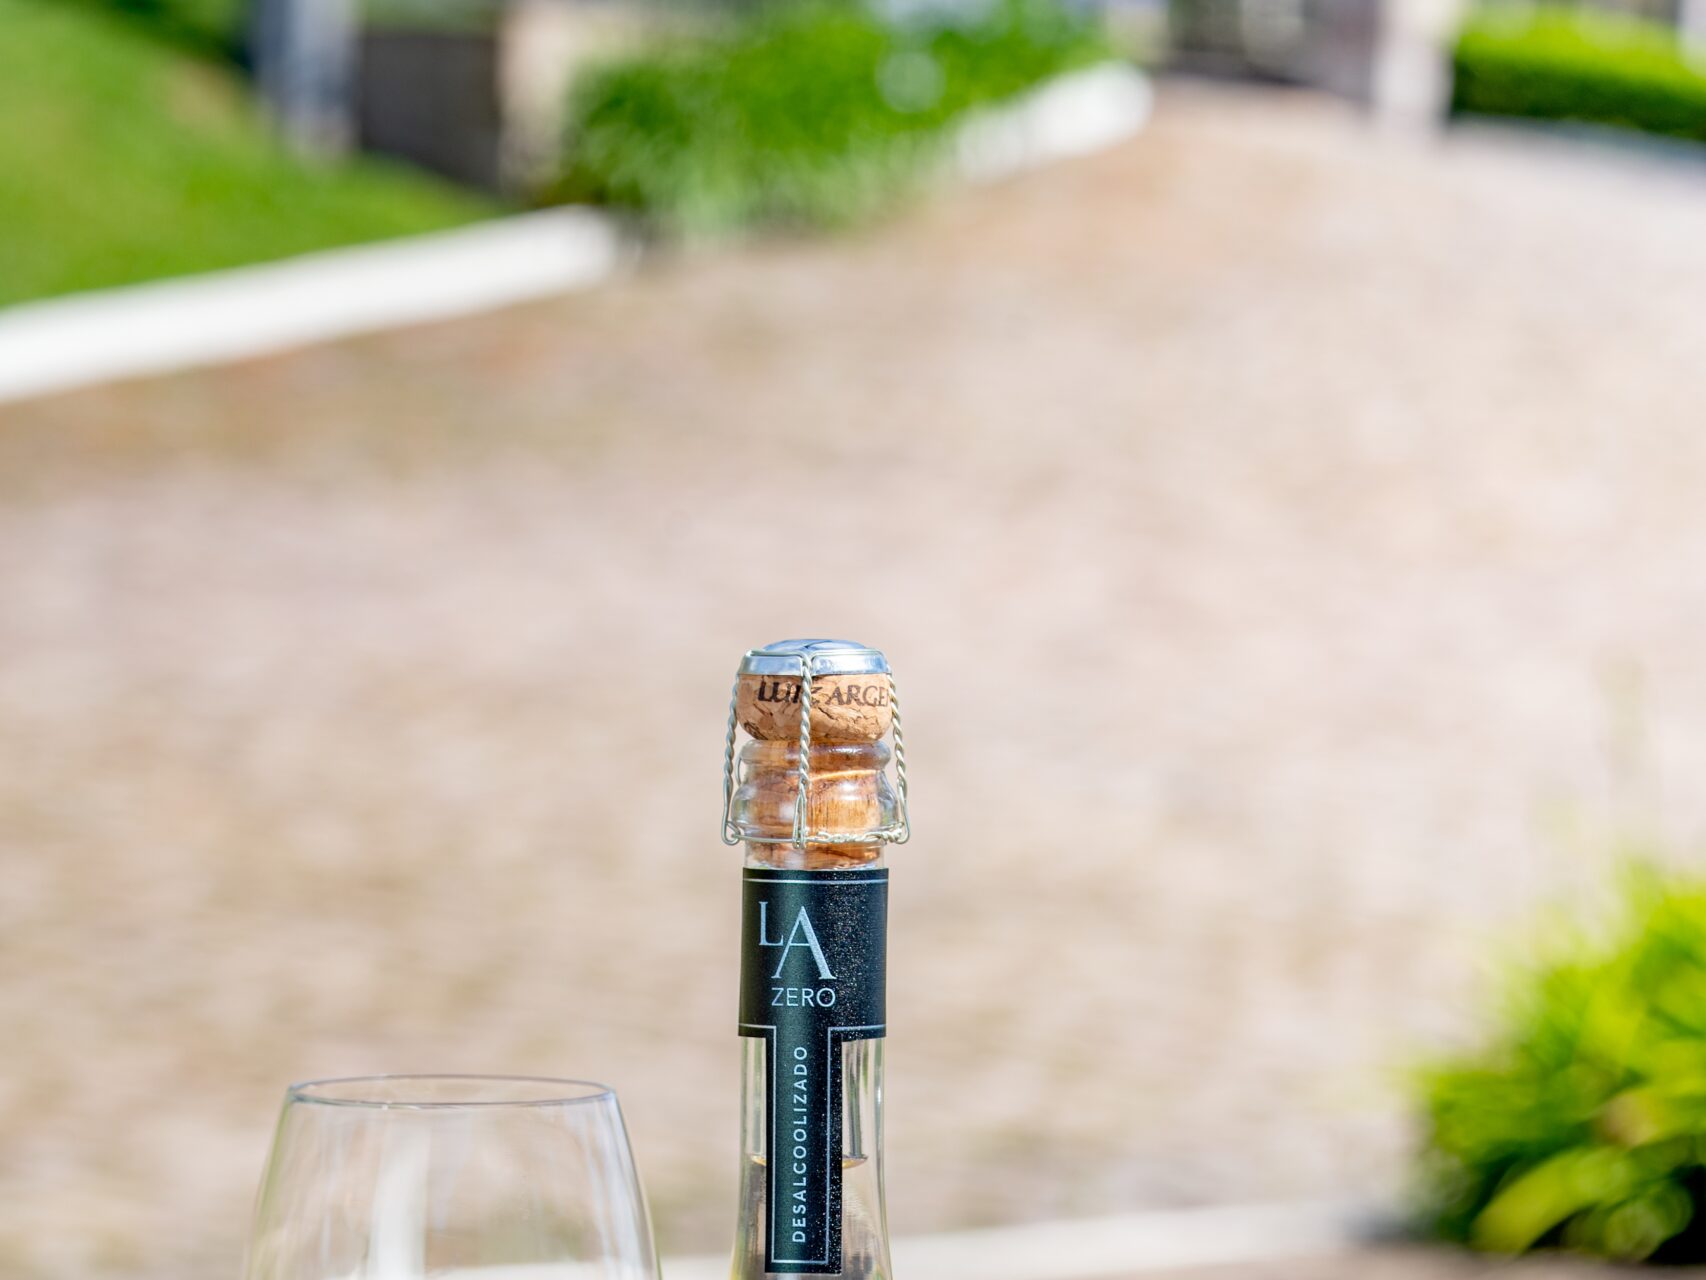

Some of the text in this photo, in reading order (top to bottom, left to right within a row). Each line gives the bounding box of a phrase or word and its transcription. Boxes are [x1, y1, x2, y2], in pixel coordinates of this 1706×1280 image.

[758, 901, 836, 980] LA
[771, 987, 836, 1007] ZERO
[791, 1046, 808, 1243] DESALCOOLIZADO
